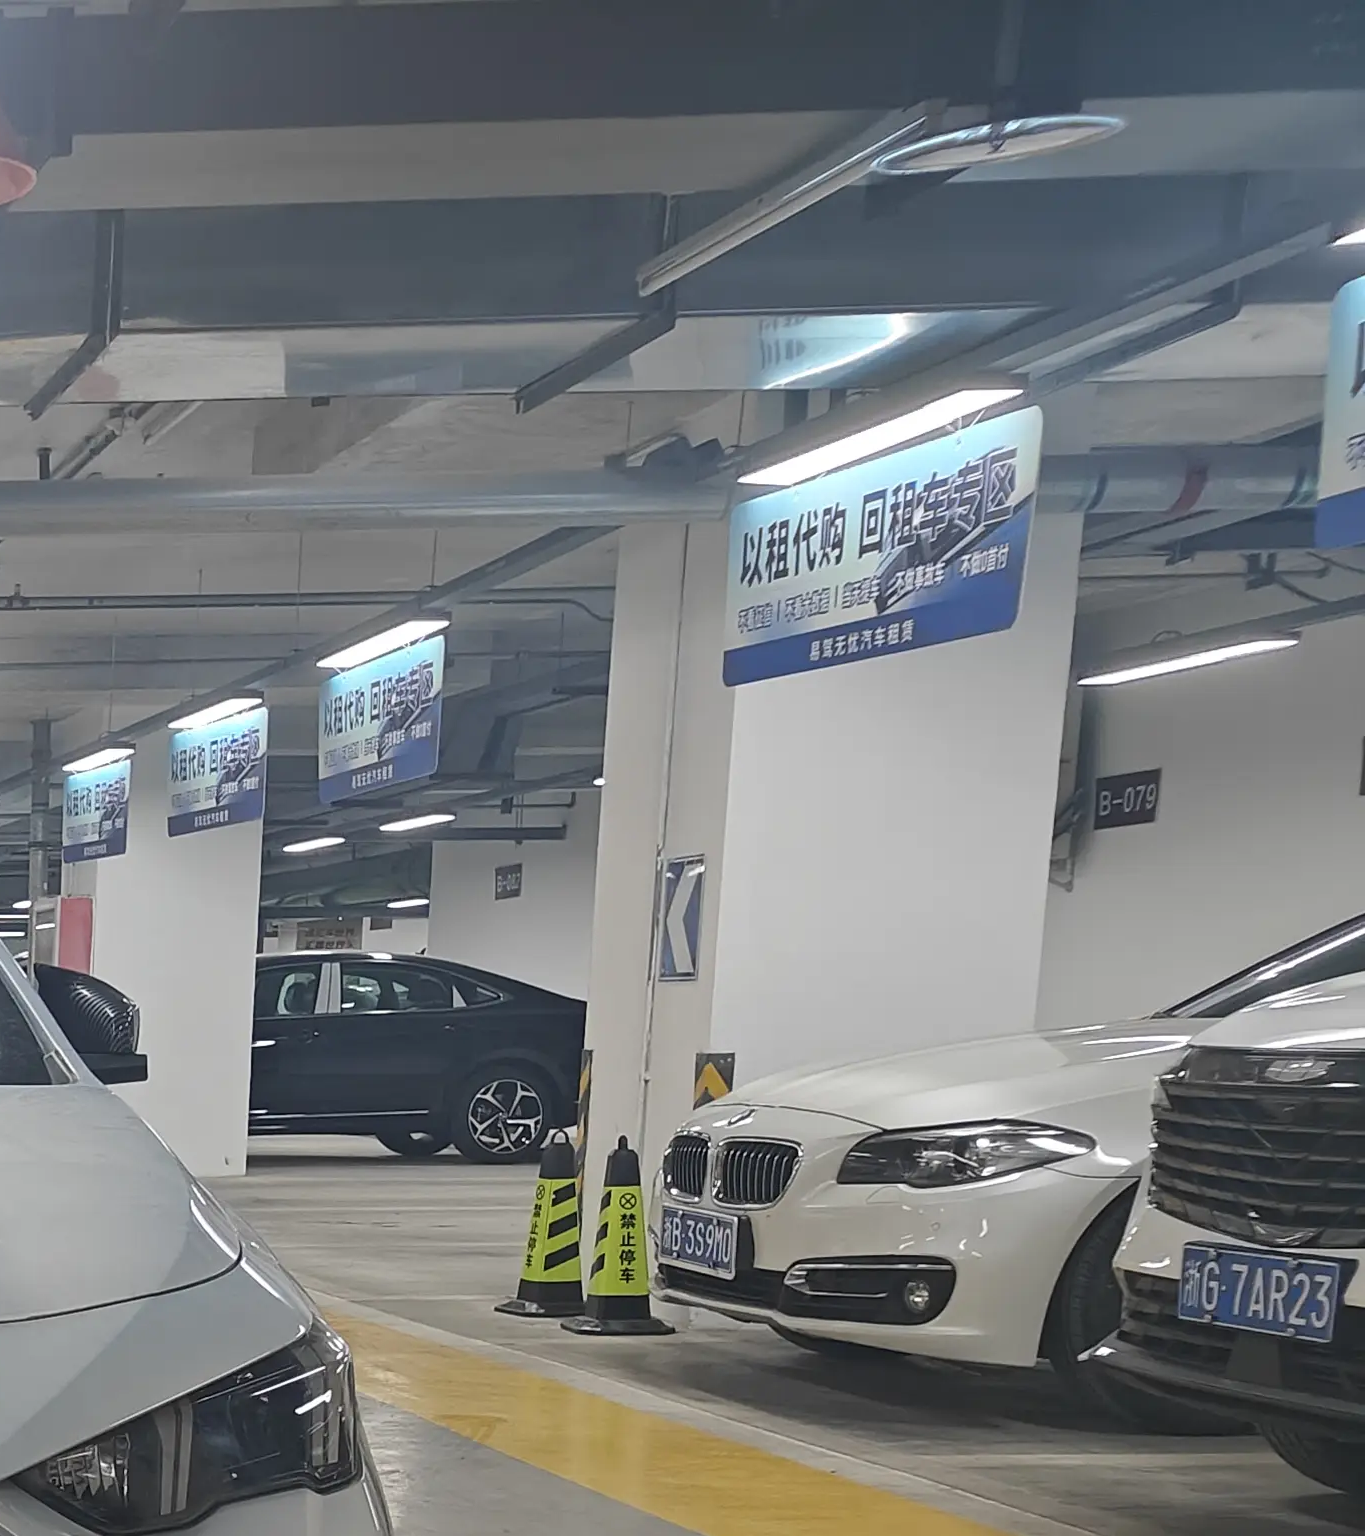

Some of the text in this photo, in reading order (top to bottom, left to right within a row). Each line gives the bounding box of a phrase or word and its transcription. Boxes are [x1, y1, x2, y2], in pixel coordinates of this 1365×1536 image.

[740, 445, 1019, 587] 以租代购 回租车专区
[810, 619, 914, 661] 易驾无忧汽车租赁
[324, 660, 433, 738] 以租代购 回租车专区
[1099, 783, 1156, 816] B-079
[526, 1203, 542, 1268] 禁止停车
[619, 1213, 637, 1284] 禁止停车
[1183, 1259, 1332, 1328] 浙G·7AR23
